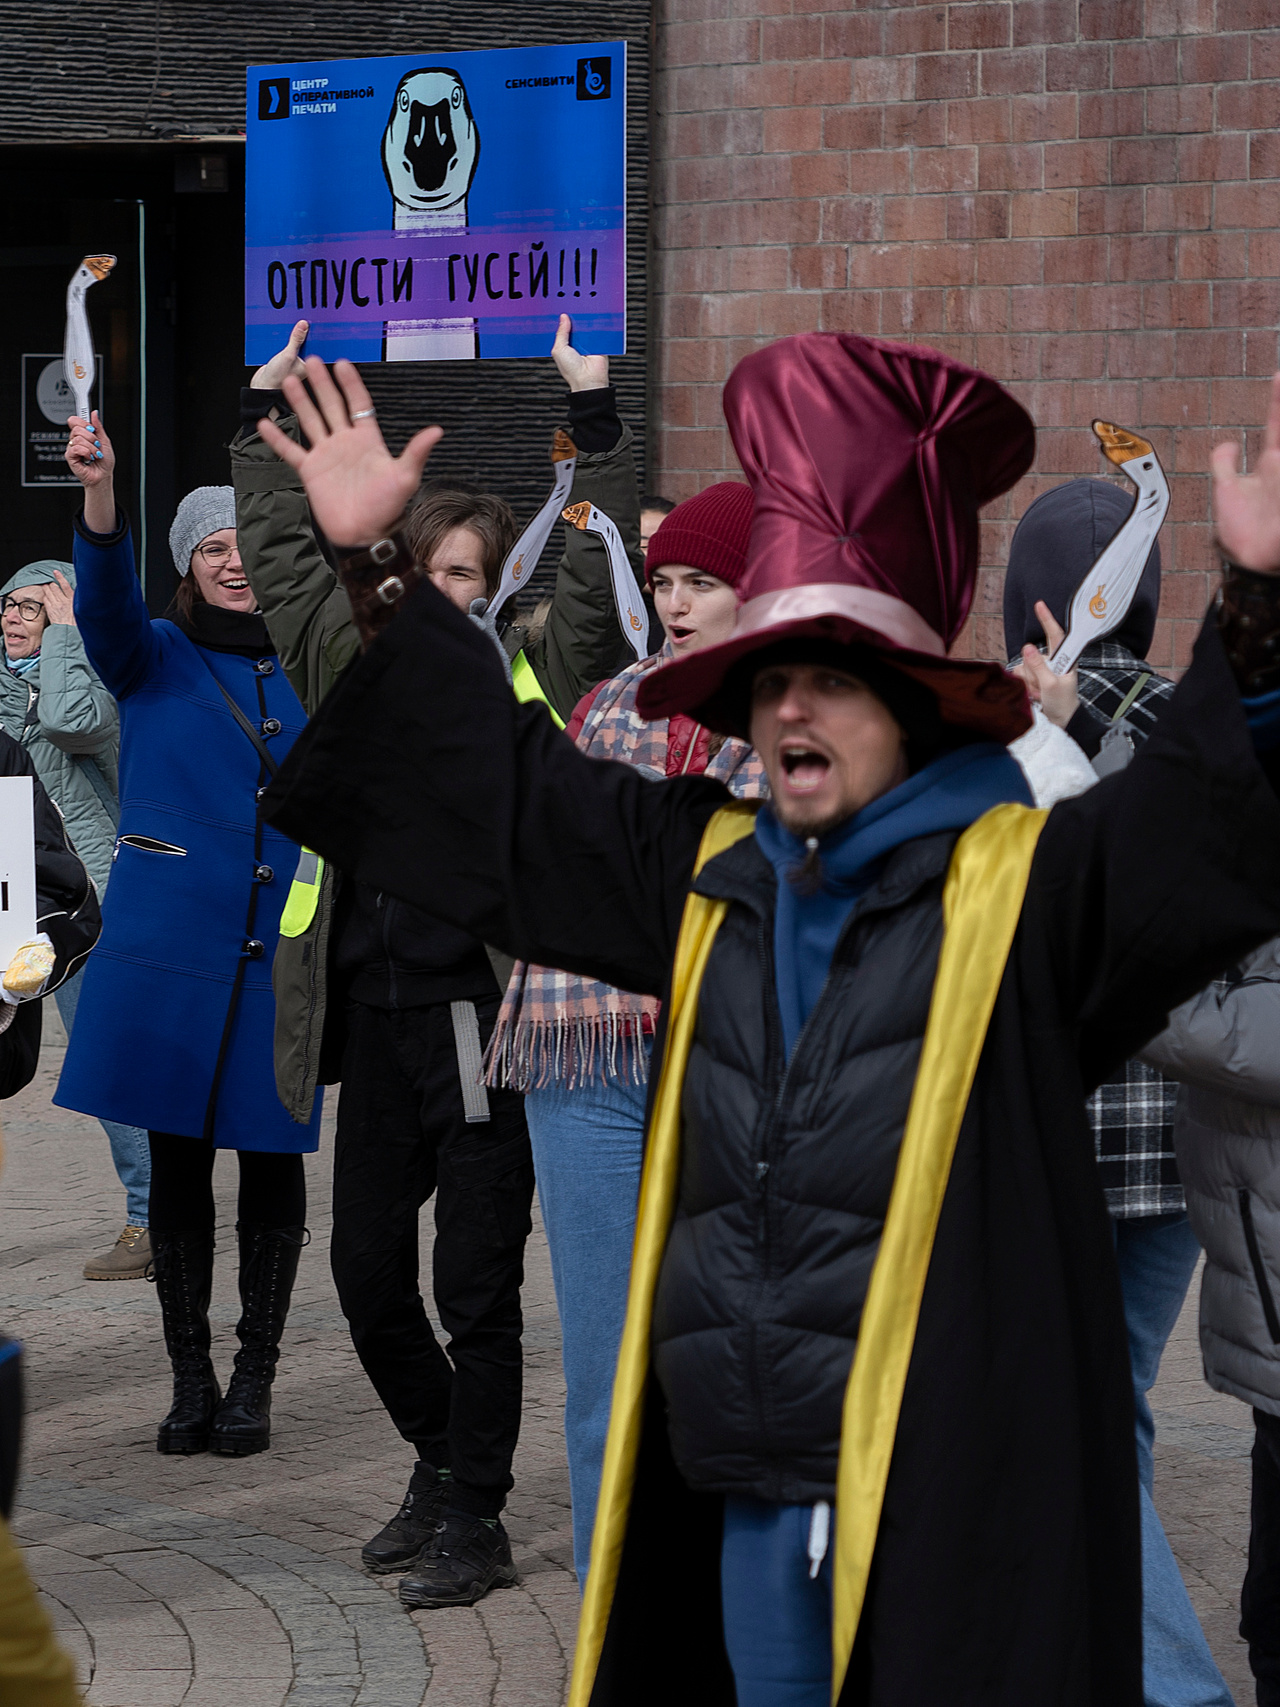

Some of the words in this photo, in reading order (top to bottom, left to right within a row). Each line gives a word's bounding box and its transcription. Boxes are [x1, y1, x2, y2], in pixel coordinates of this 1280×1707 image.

[292, 78, 329, 91] ЦЕНТР
[505, 75, 575, 89] СЕНСИВИТИ
[292, 86, 375, 102] ОПЕРАТИВНОЙ
[292, 103, 337, 115] ПЕЧАТИ
[267, 255, 413, 310] ОТПУСТИ
[448, 241, 599, 303] ГУСЕЙ!!!
